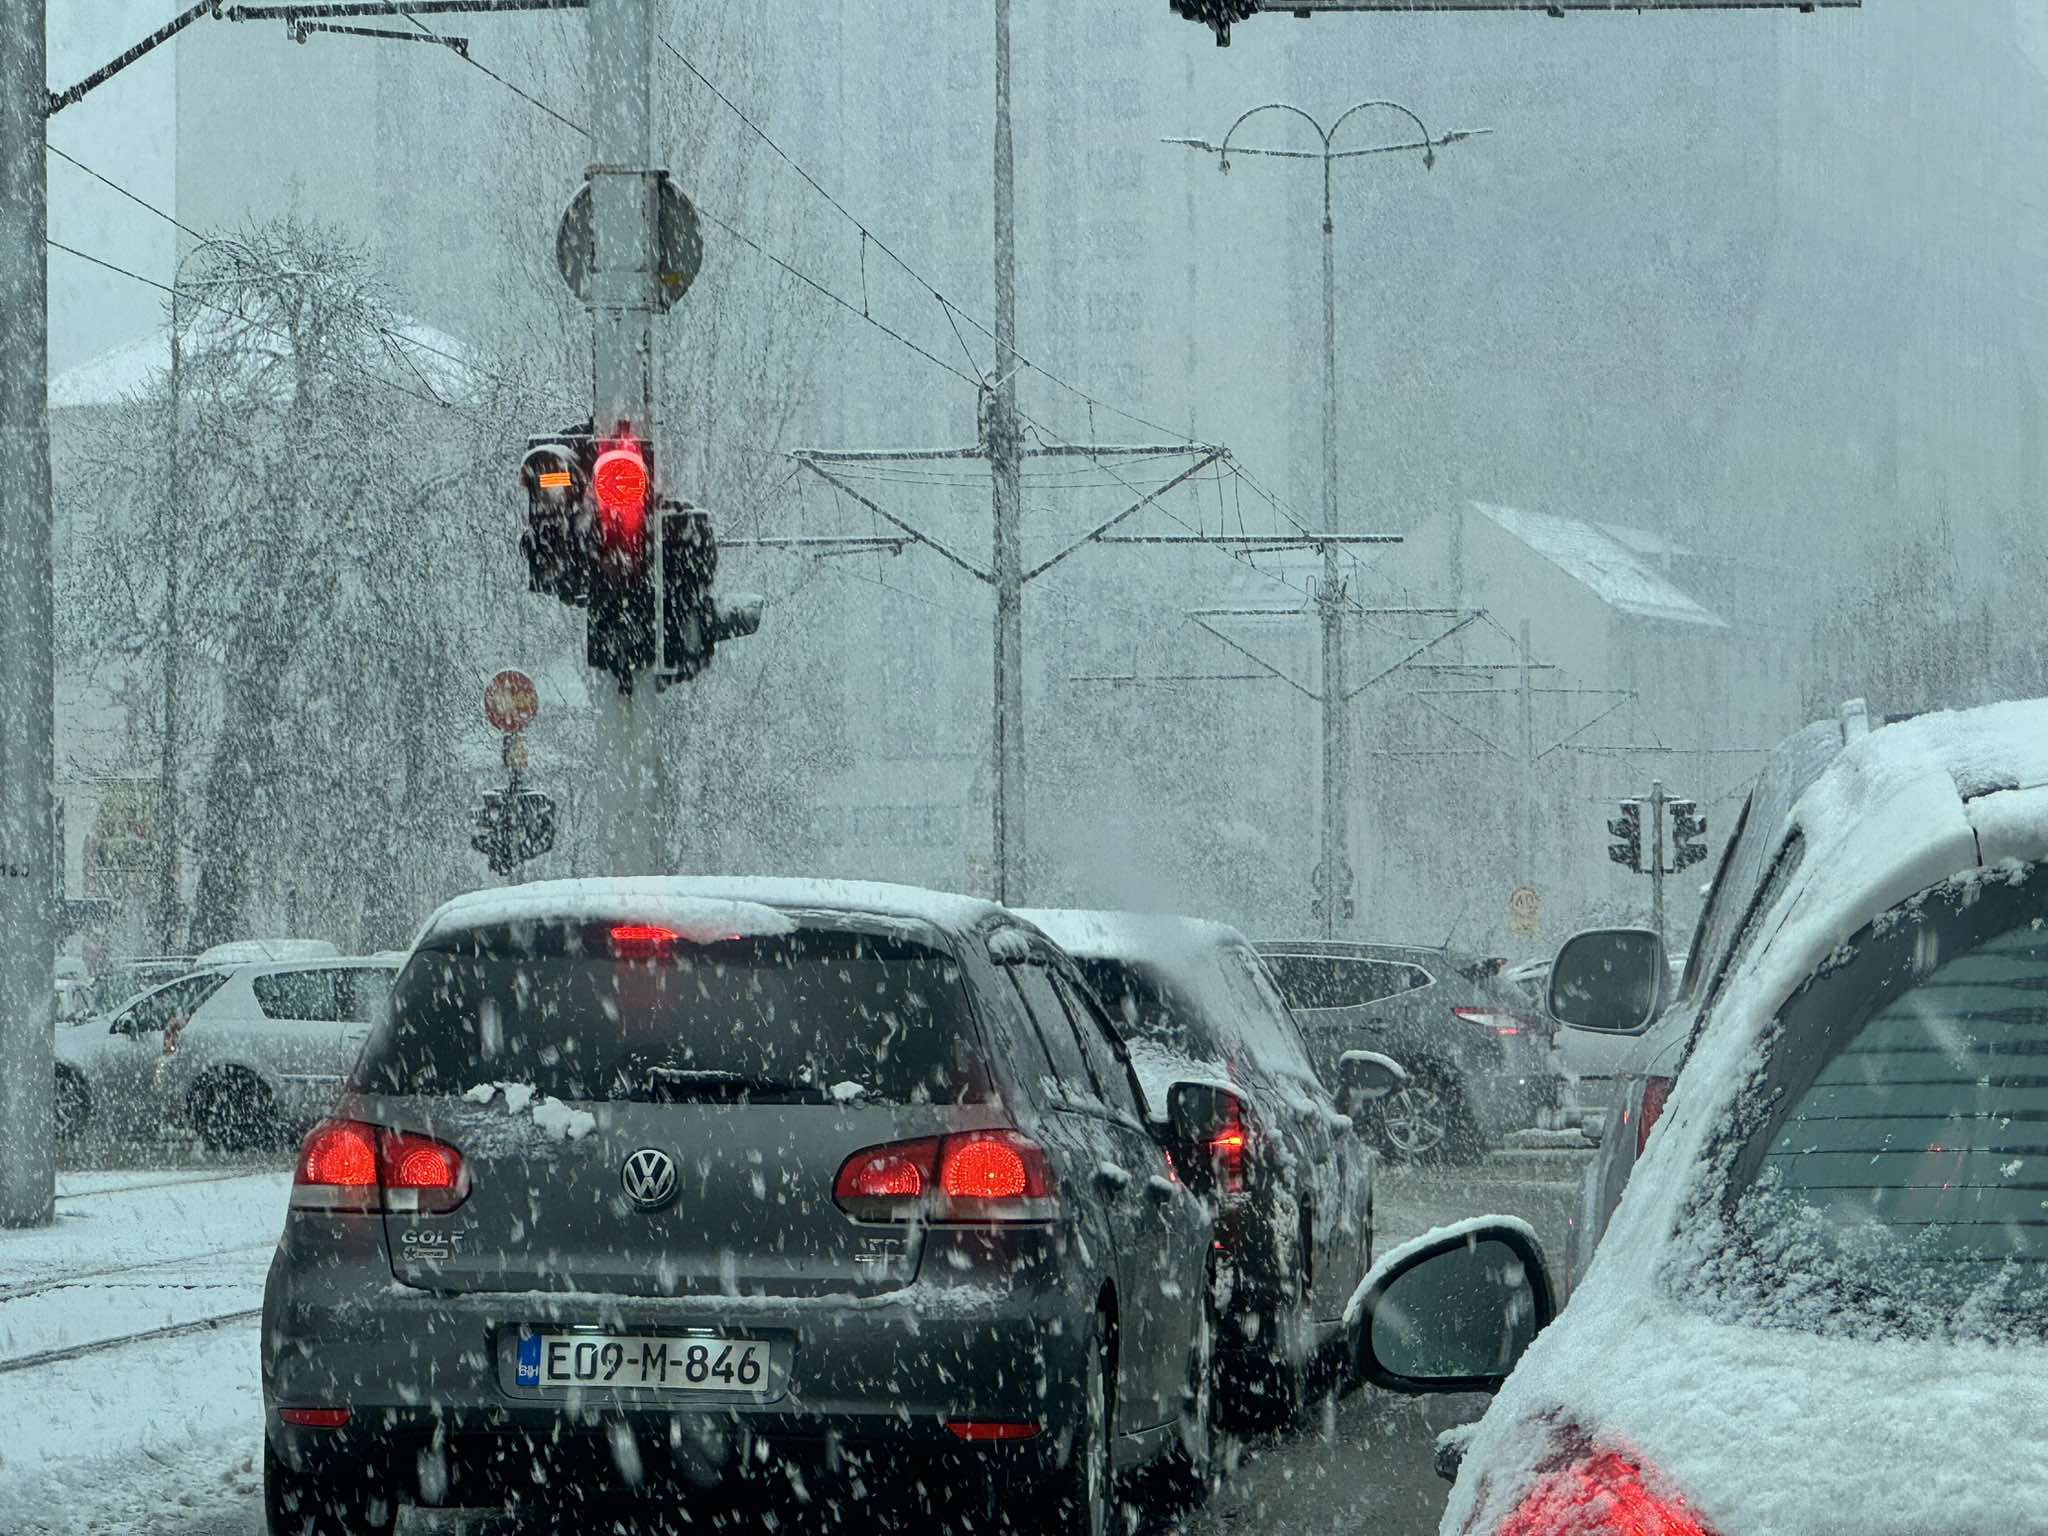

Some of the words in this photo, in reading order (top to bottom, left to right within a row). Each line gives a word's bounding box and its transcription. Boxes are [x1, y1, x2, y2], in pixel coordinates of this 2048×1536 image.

[622, 1149, 675, 1202] VW
[402, 1230, 464, 1246] GOLF
[547, 1341, 761, 1385] E09-M-846
